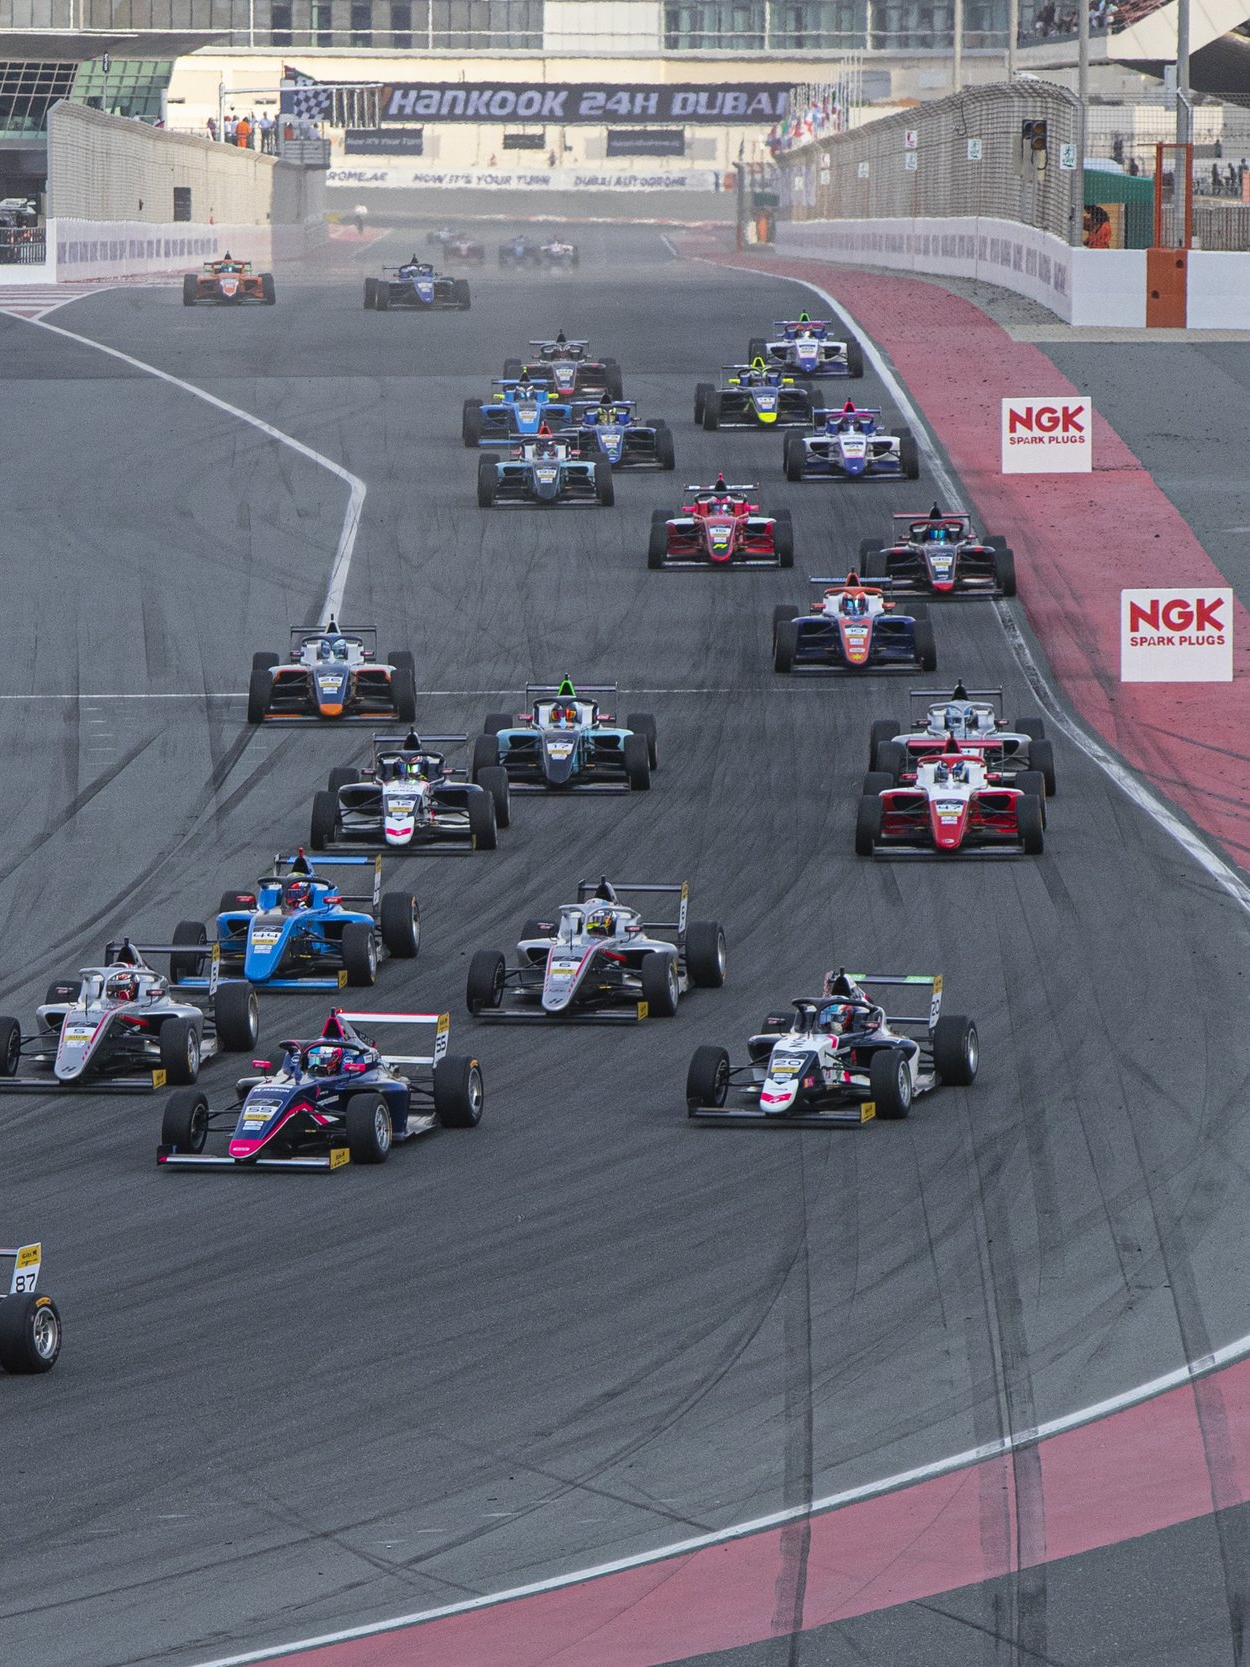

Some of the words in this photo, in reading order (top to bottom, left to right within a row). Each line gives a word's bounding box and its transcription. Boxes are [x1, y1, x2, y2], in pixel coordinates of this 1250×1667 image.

[580, 91, 658, 116] 24H
[412, 172, 446, 184] NOW
[477, 174, 511, 185] YOUR
[1009, 404, 1085, 433] NGK
[1009, 436, 1045, 445] SPARK
[1048, 435, 1085, 444] PLUGS
[1129, 597, 1225, 632] NGK
[1130, 636, 1175, 646] SPARK
[1179, 635, 1225, 646] PLUGS
[436, 1035, 446, 1054] 55
[15, 1273, 35, 1293] 87
